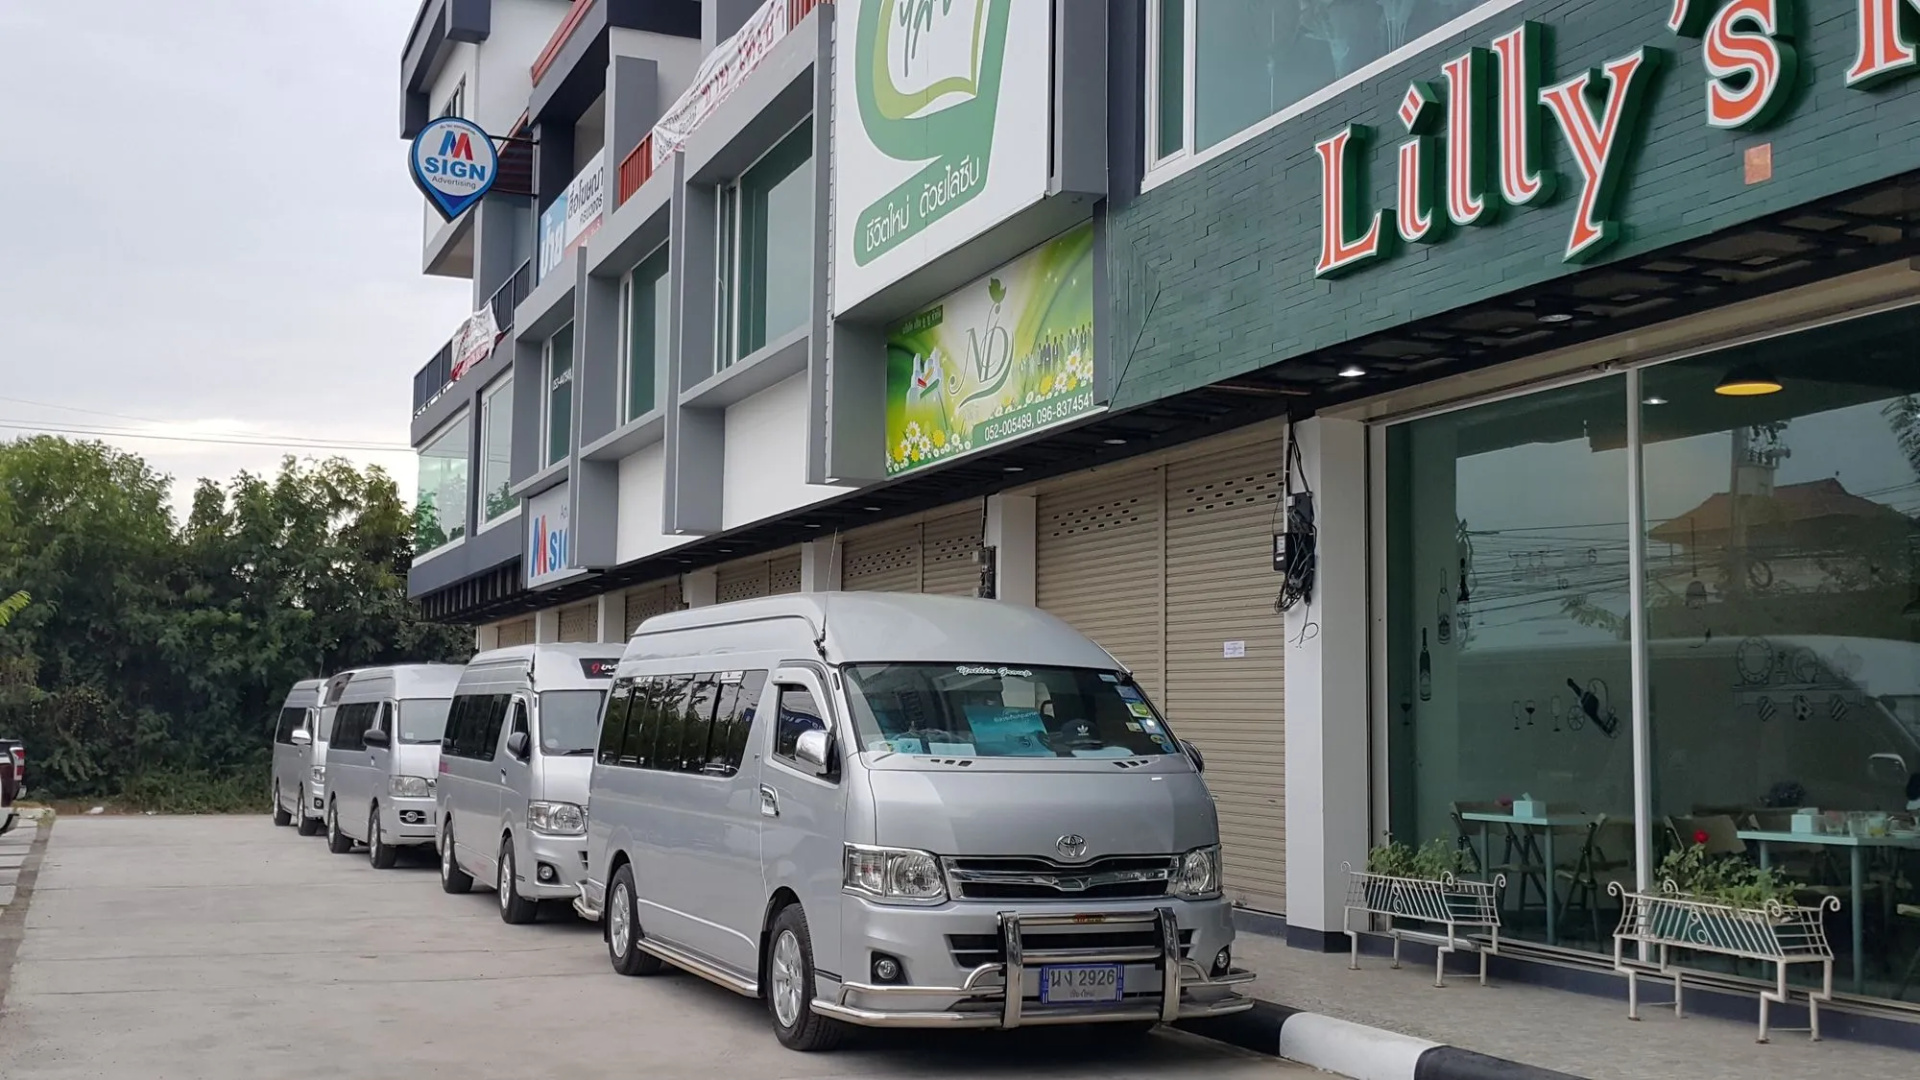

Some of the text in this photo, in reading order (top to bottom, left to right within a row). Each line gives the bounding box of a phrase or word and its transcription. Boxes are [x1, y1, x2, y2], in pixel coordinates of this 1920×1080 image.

[1314, 0, 1783, 278] Lilly's
[424, 156, 486, 182] SIGN
[431, 175, 476, 190] Advertising
[866, 194, 910, 252] ชีวิตใหม่
[984, 391, 1095, 441] 052-005489, 096-8374541
[549, 527, 569, 572] SI
[1078, 969, 1115, 986] 2926
